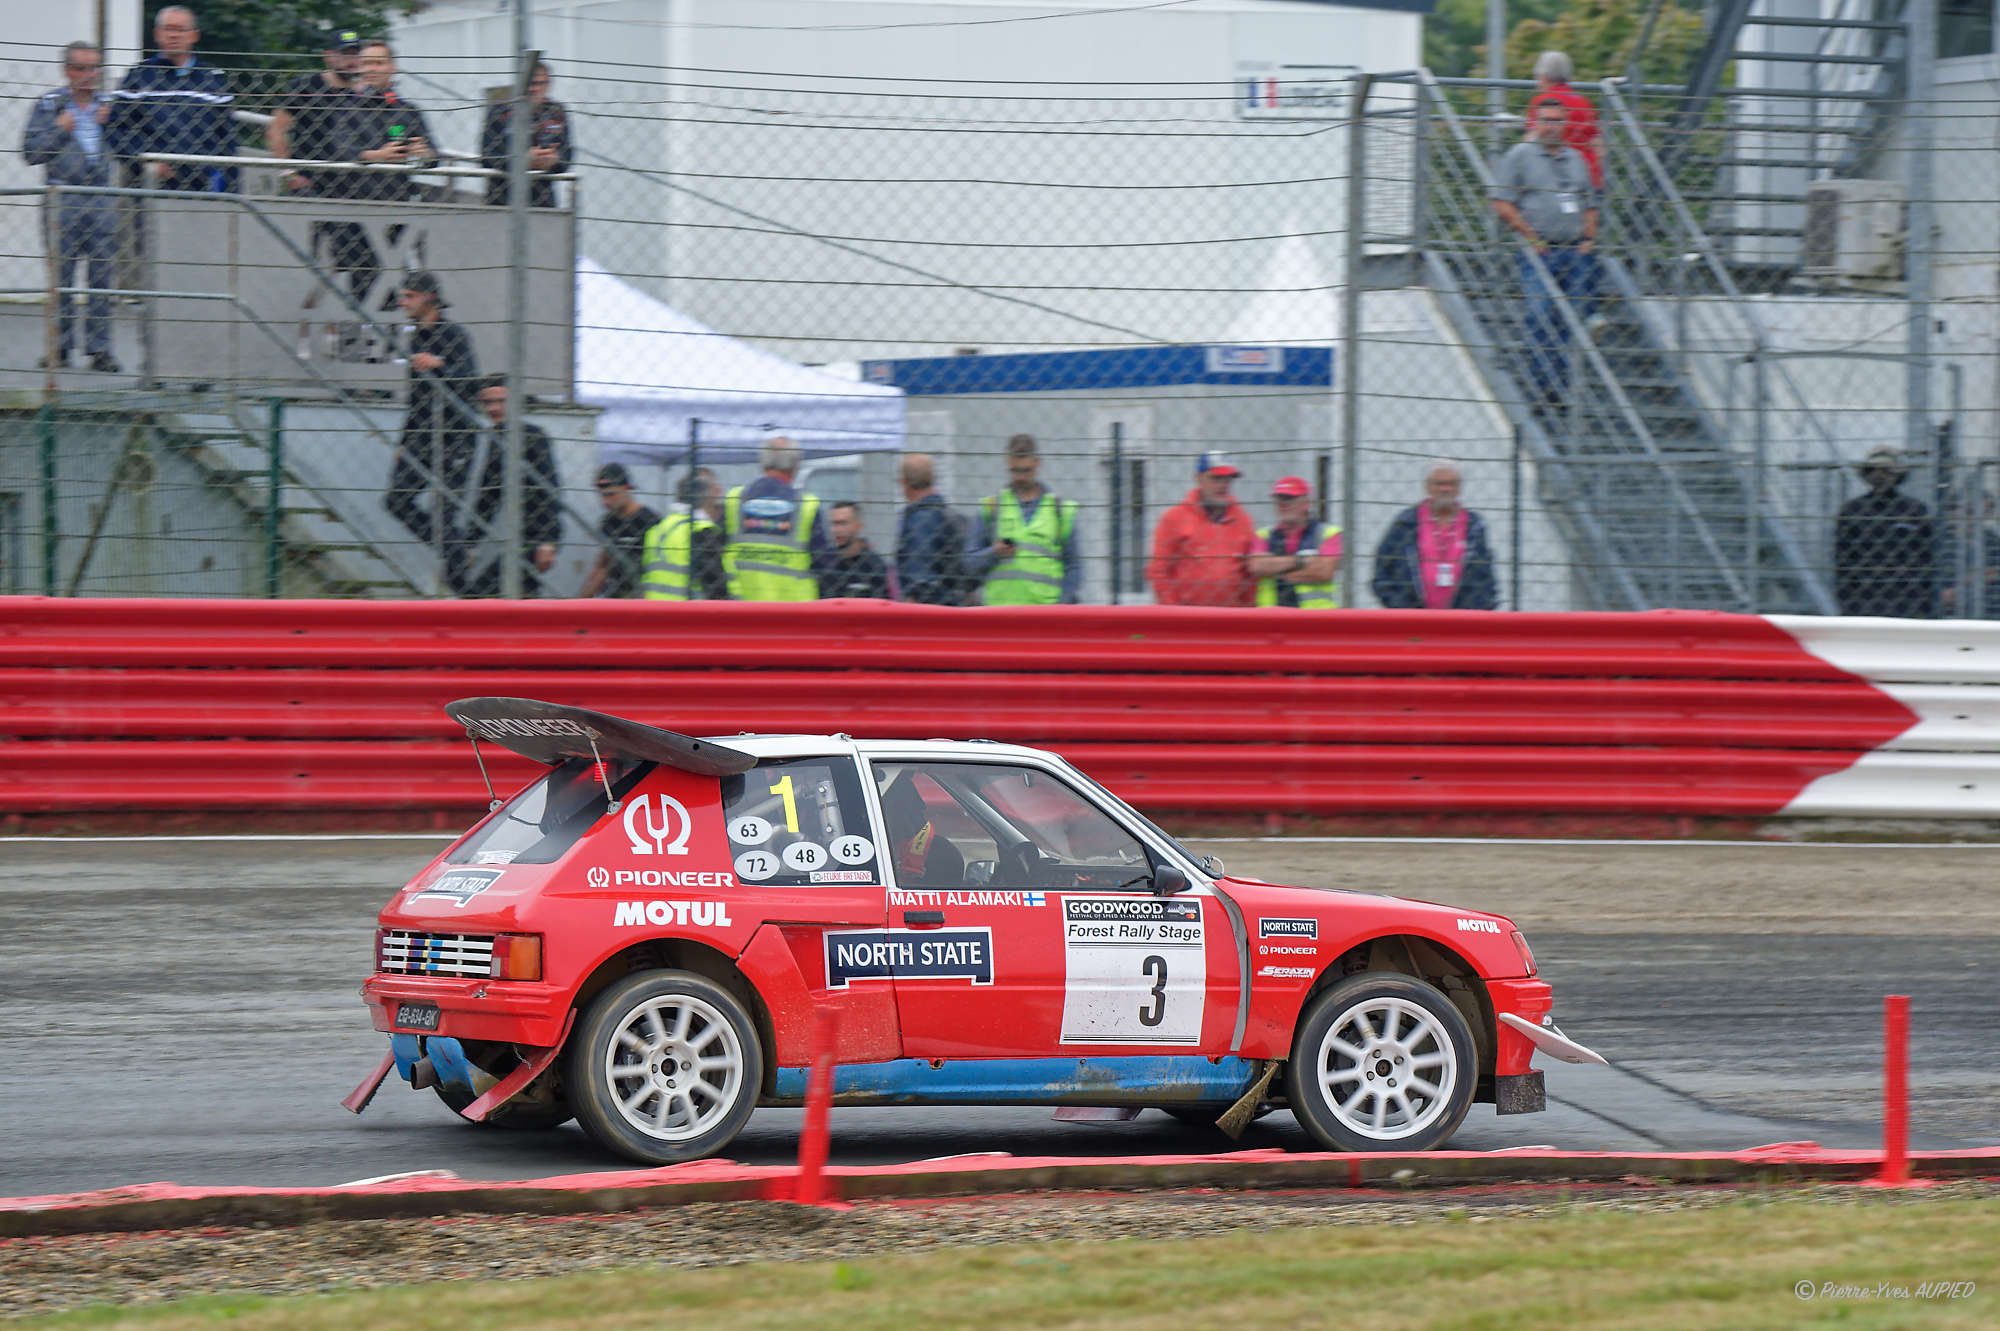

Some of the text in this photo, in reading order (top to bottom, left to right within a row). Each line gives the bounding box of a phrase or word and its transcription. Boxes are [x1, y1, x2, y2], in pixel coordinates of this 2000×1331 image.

[769, 776, 799, 833] 1
[740, 823, 758, 838] 63
[795, 849, 815, 864] 48
[842, 843, 861, 858] 65
[746, 858, 768, 873] 72
[615, 870, 734, 887] PIONEER
[889, 892, 1022, 906] MATTI ALAMAKI
[613, 900, 732, 927] MOTUL
[1069, 902, 1164, 914] GOODWOOD
[1068, 924, 1201, 941] Forest Rally Stage
[1263, 922, 1314, 932] NORTH STATE
[1456, 918, 1501, 934] MOTUL
[837, 942, 982, 967] NORTH STATE
[1270, 946, 1317, 955] PIONEER
[1139, 955, 1168, 1027] 3
